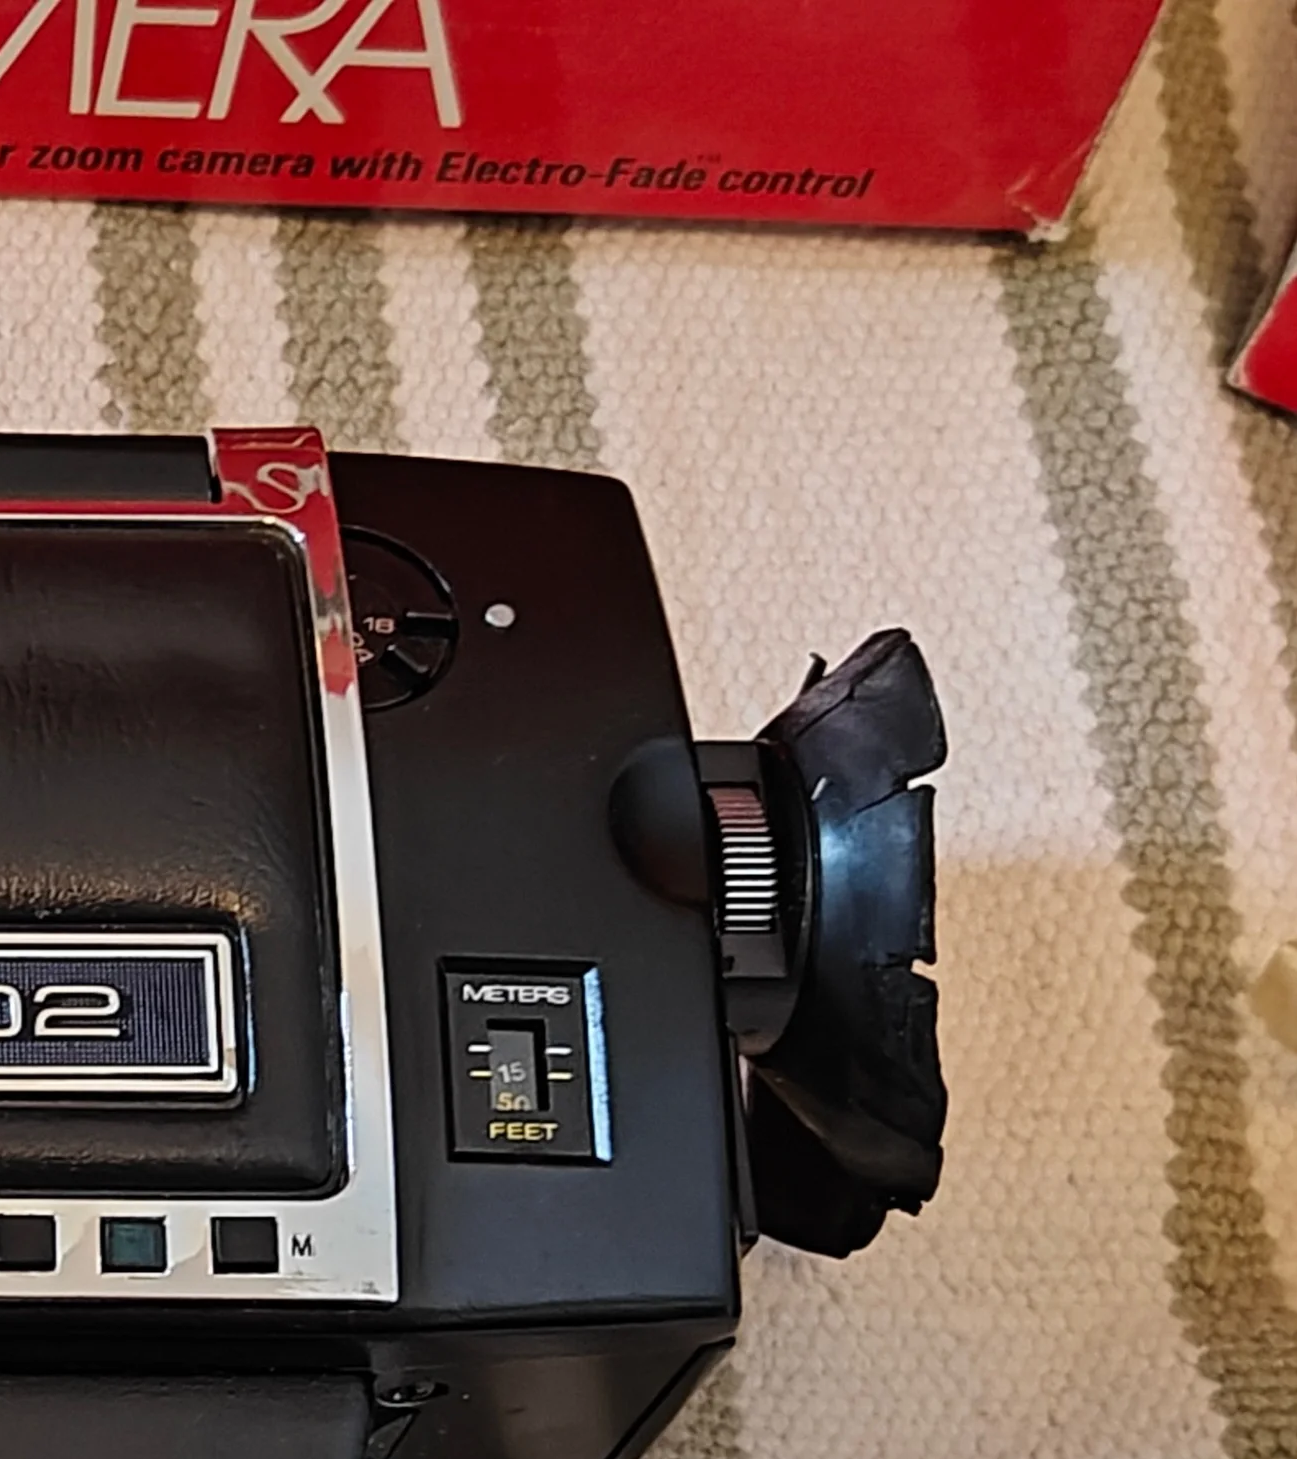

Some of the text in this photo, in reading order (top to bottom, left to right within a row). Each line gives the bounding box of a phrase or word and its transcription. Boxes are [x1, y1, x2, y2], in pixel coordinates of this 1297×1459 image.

[28, 143, 144, 173] zoom
[157, 146, 315, 178] camera
[313, 150, 425, 183] with
[716, 165, 877, 199] control
[462, 984, 572, 1005] METERS
[497, 1061, 527, 1084] 15
[489, 1122, 558, 1141] FEET
[292, 1235, 312, 1257] M
